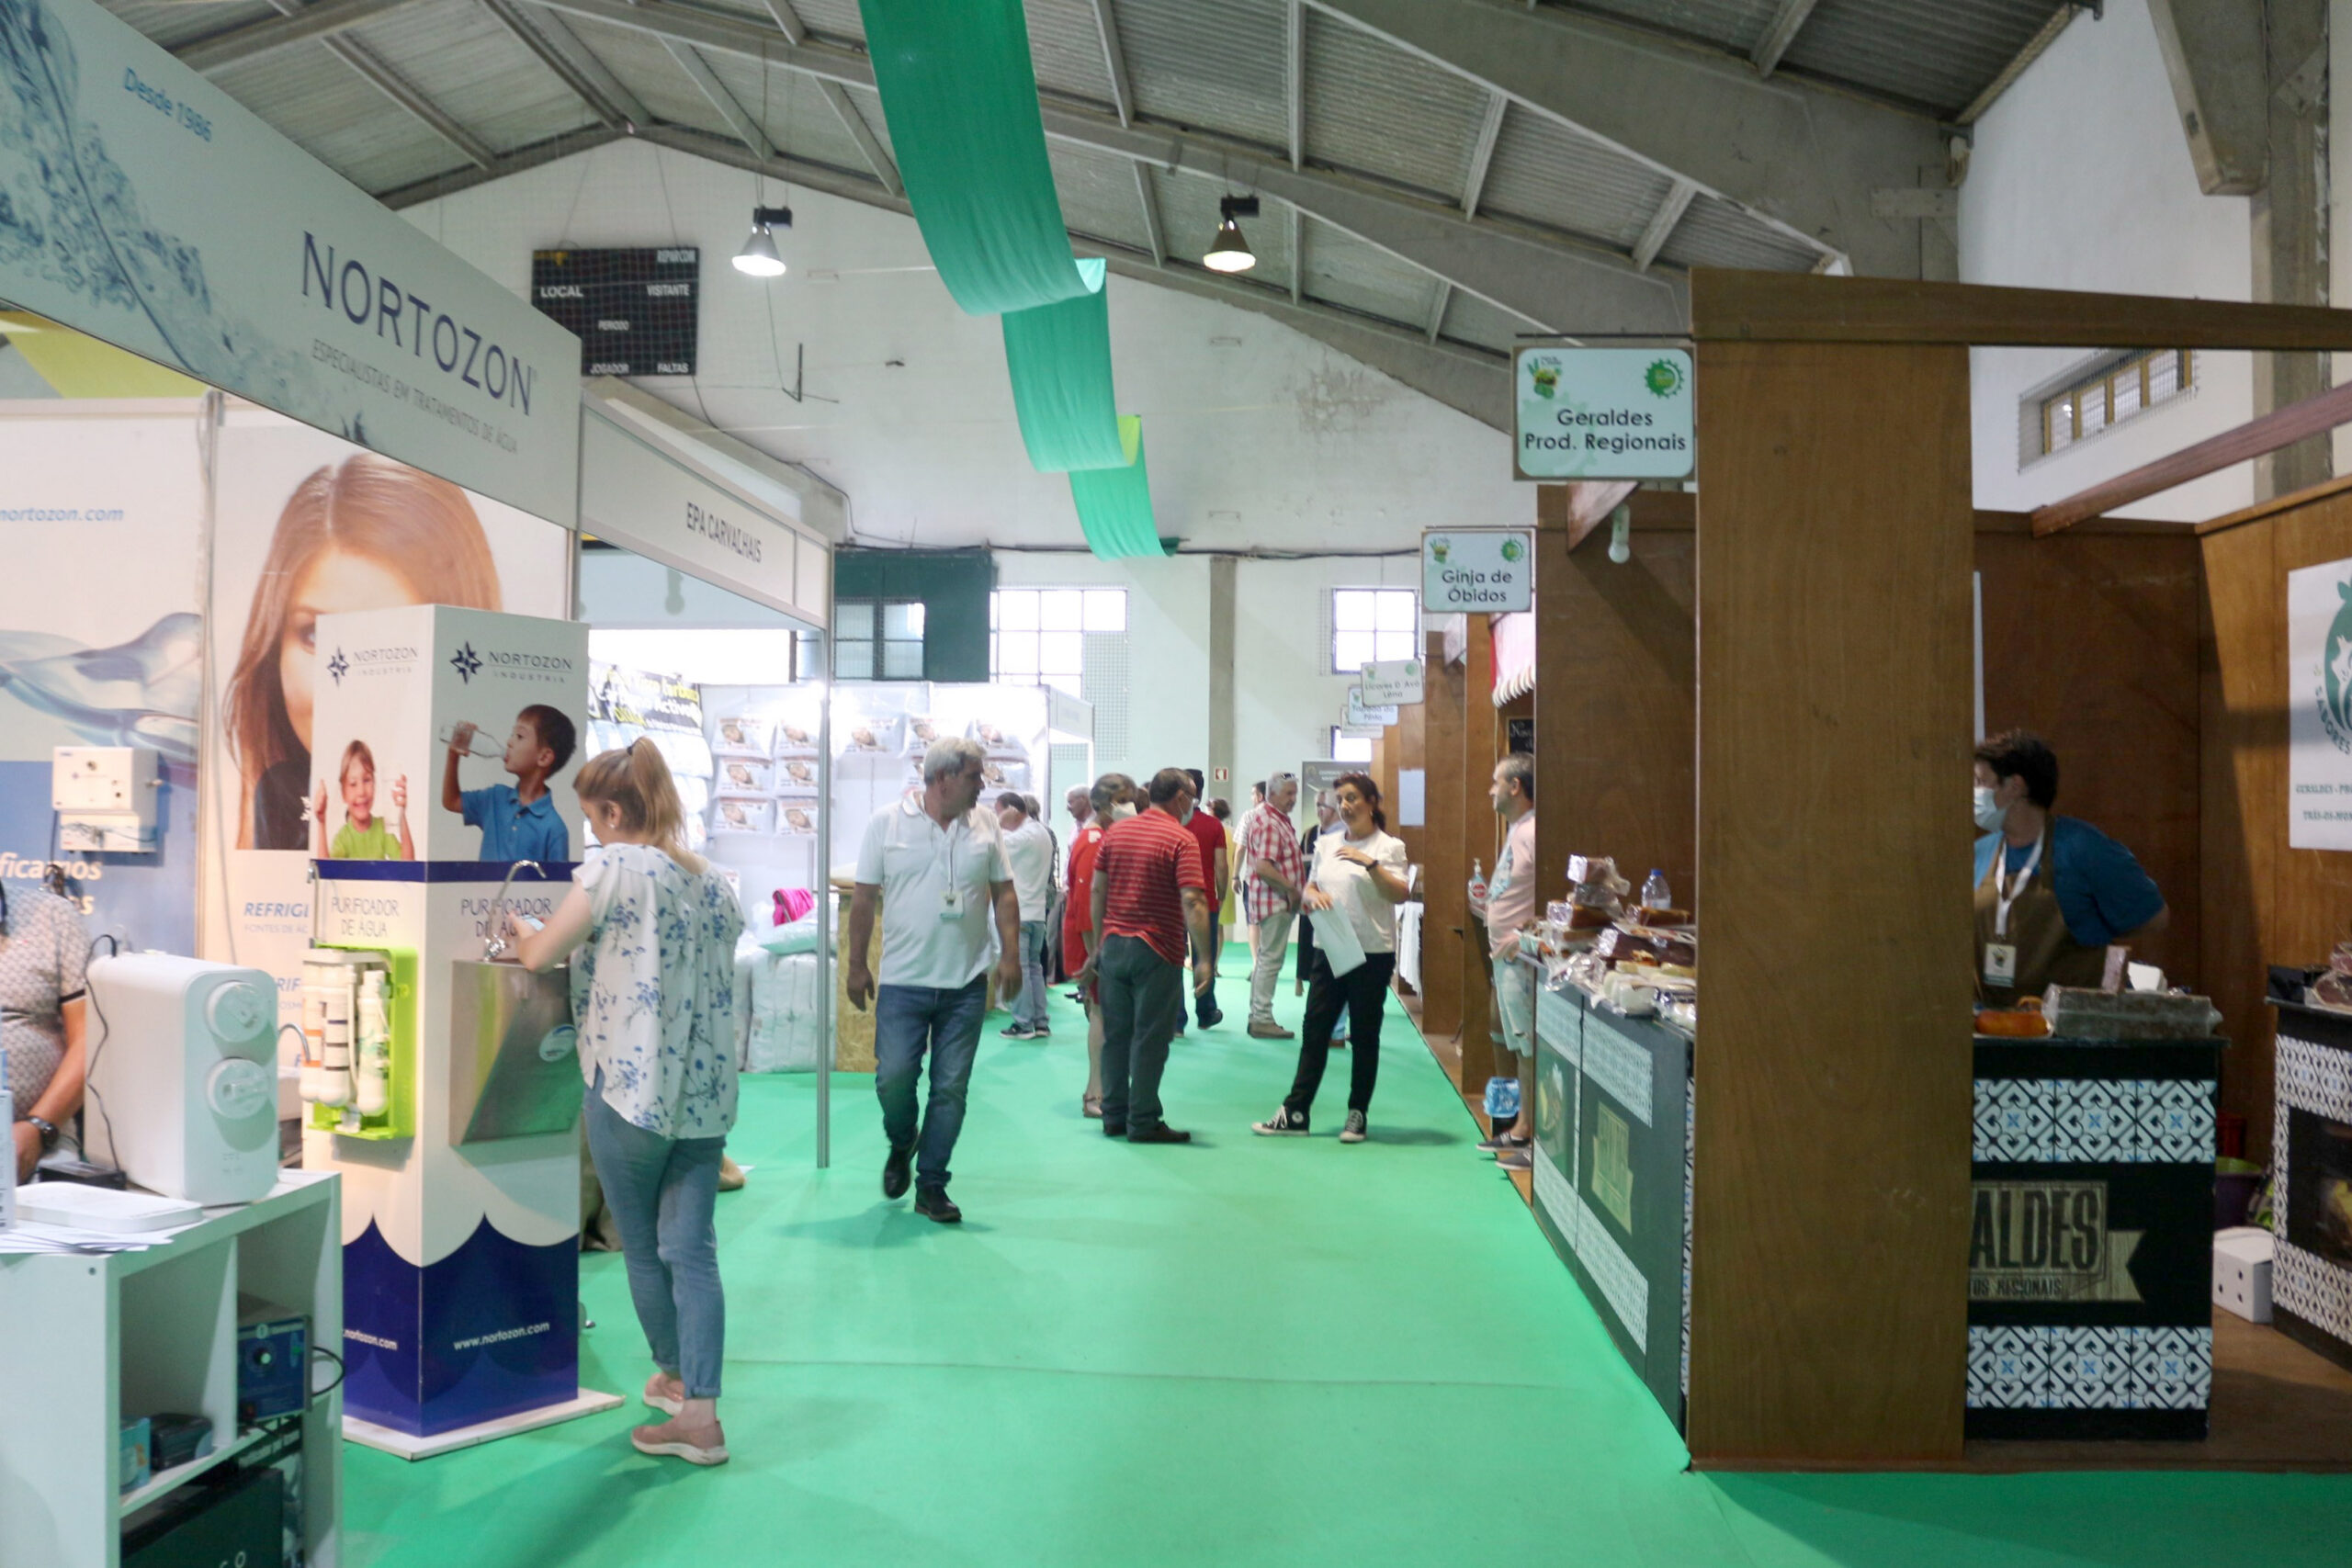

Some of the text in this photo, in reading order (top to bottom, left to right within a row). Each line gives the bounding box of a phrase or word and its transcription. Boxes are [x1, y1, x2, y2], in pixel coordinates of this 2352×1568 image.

[123, 66, 213, 142] Desde 1986
[540, 284, 690, 298] LOCAL VISITANTE
[301, 231, 532, 415] NORTOZON
[657, 362, 689, 374] FALTAS
[312, 338, 390, 393] ESPECIALISTAS
[393, 379, 410, 402] EM
[413, 388, 479, 436] TRATAMENTOS
[481, 423, 493, 443] DE
[1557, 408, 1653, 427] Geraldes
[1525, 433, 1687, 455] Prod. Regionais
[685, 501, 762, 563] EPA CARVALHAIS
[1442, 570, 1512, 587] Ginja de
[1448, 585, 1507, 603] Óbidos
[353, 646, 418, 662] NORTOZON
[488, 650, 573, 671] NORTOZON
[331, 897, 400, 917] PURIFICADOR
[341, 919, 355, 936] DE
[453, 1321, 550, 1351] www.nortozon.com
